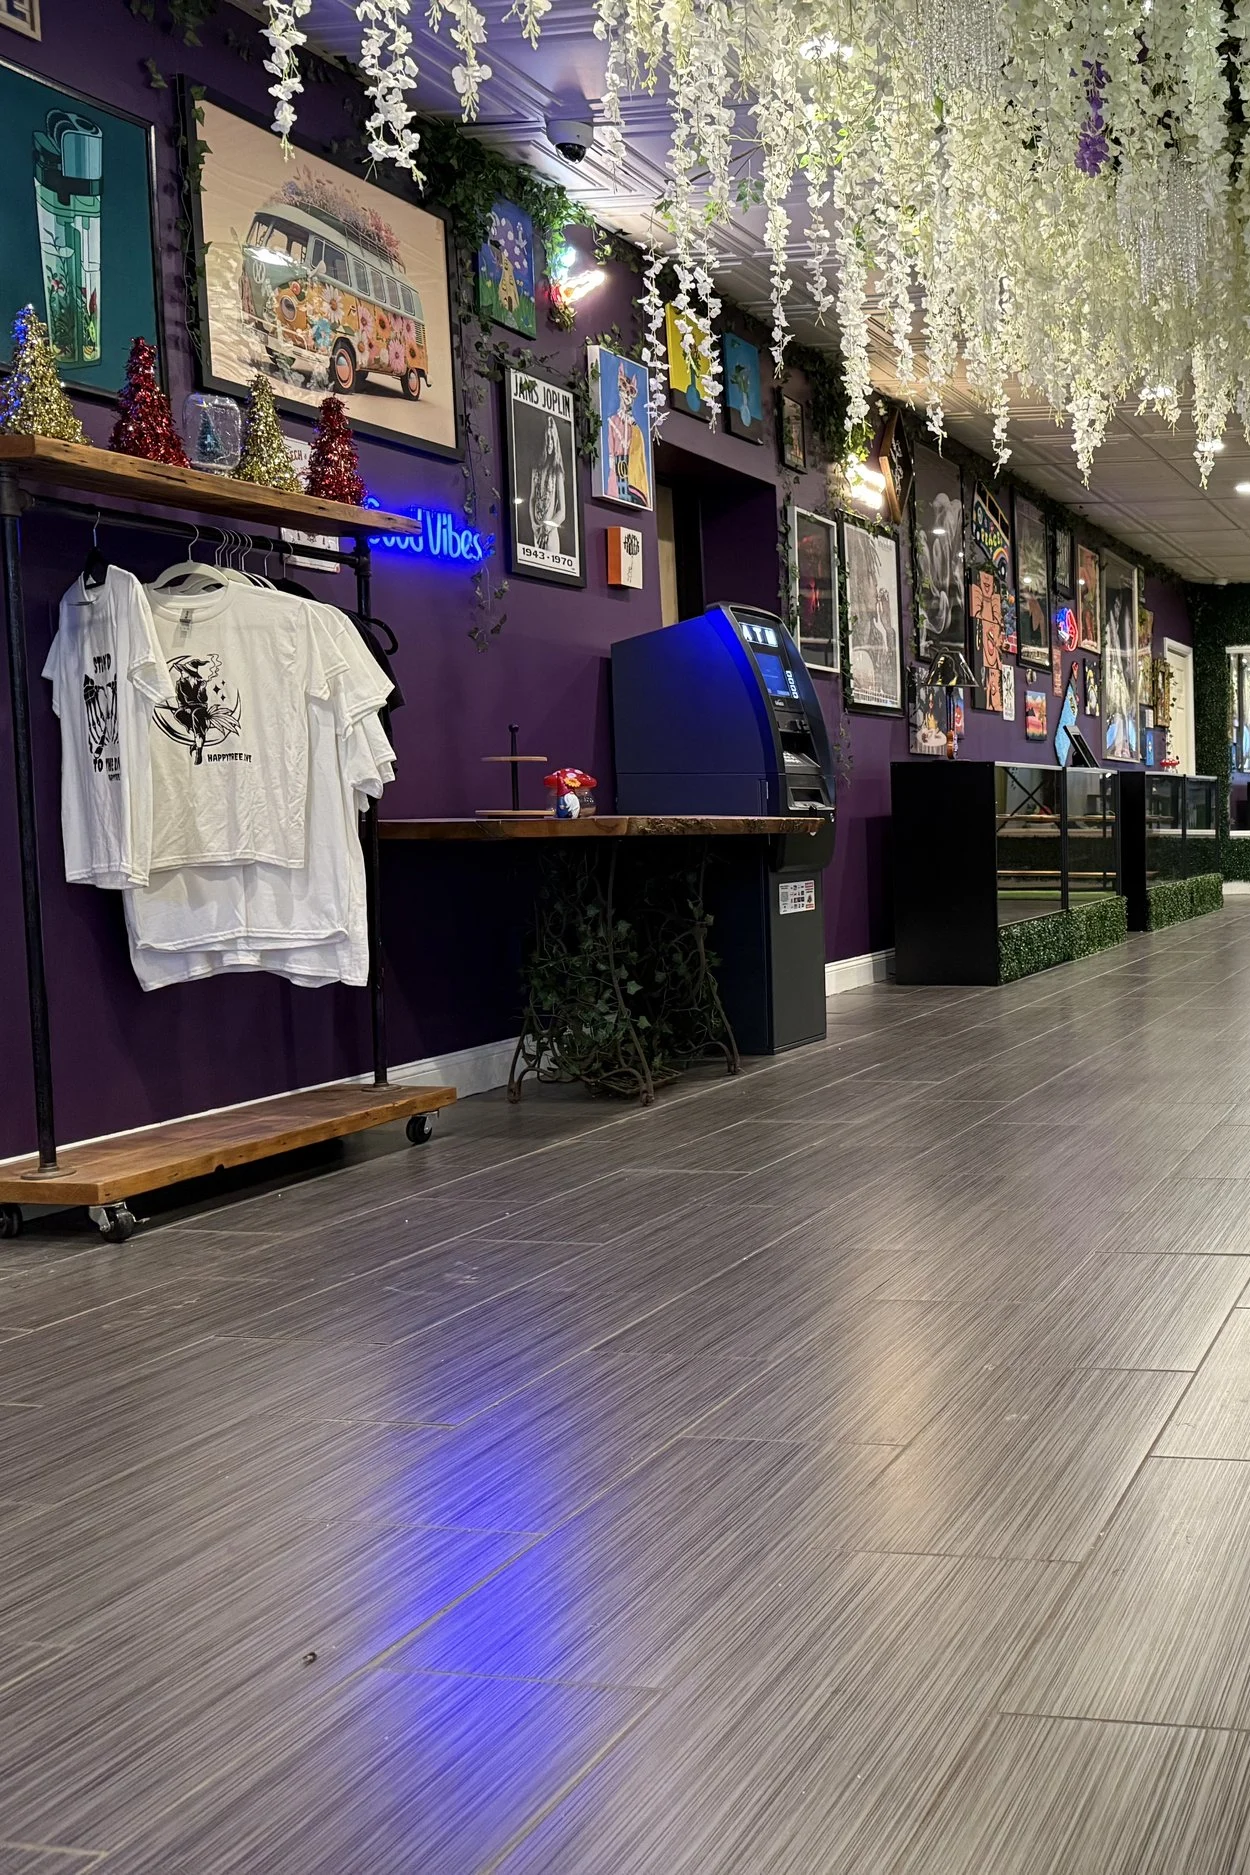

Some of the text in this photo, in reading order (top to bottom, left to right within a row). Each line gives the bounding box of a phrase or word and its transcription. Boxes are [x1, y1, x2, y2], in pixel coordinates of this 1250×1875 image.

[542, 387, 571, 418] JOPLIN
[426, 510, 482, 560] Vibes
[522, 547, 573, 567] 1943 1970
[93, 758, 104, 773] TO
